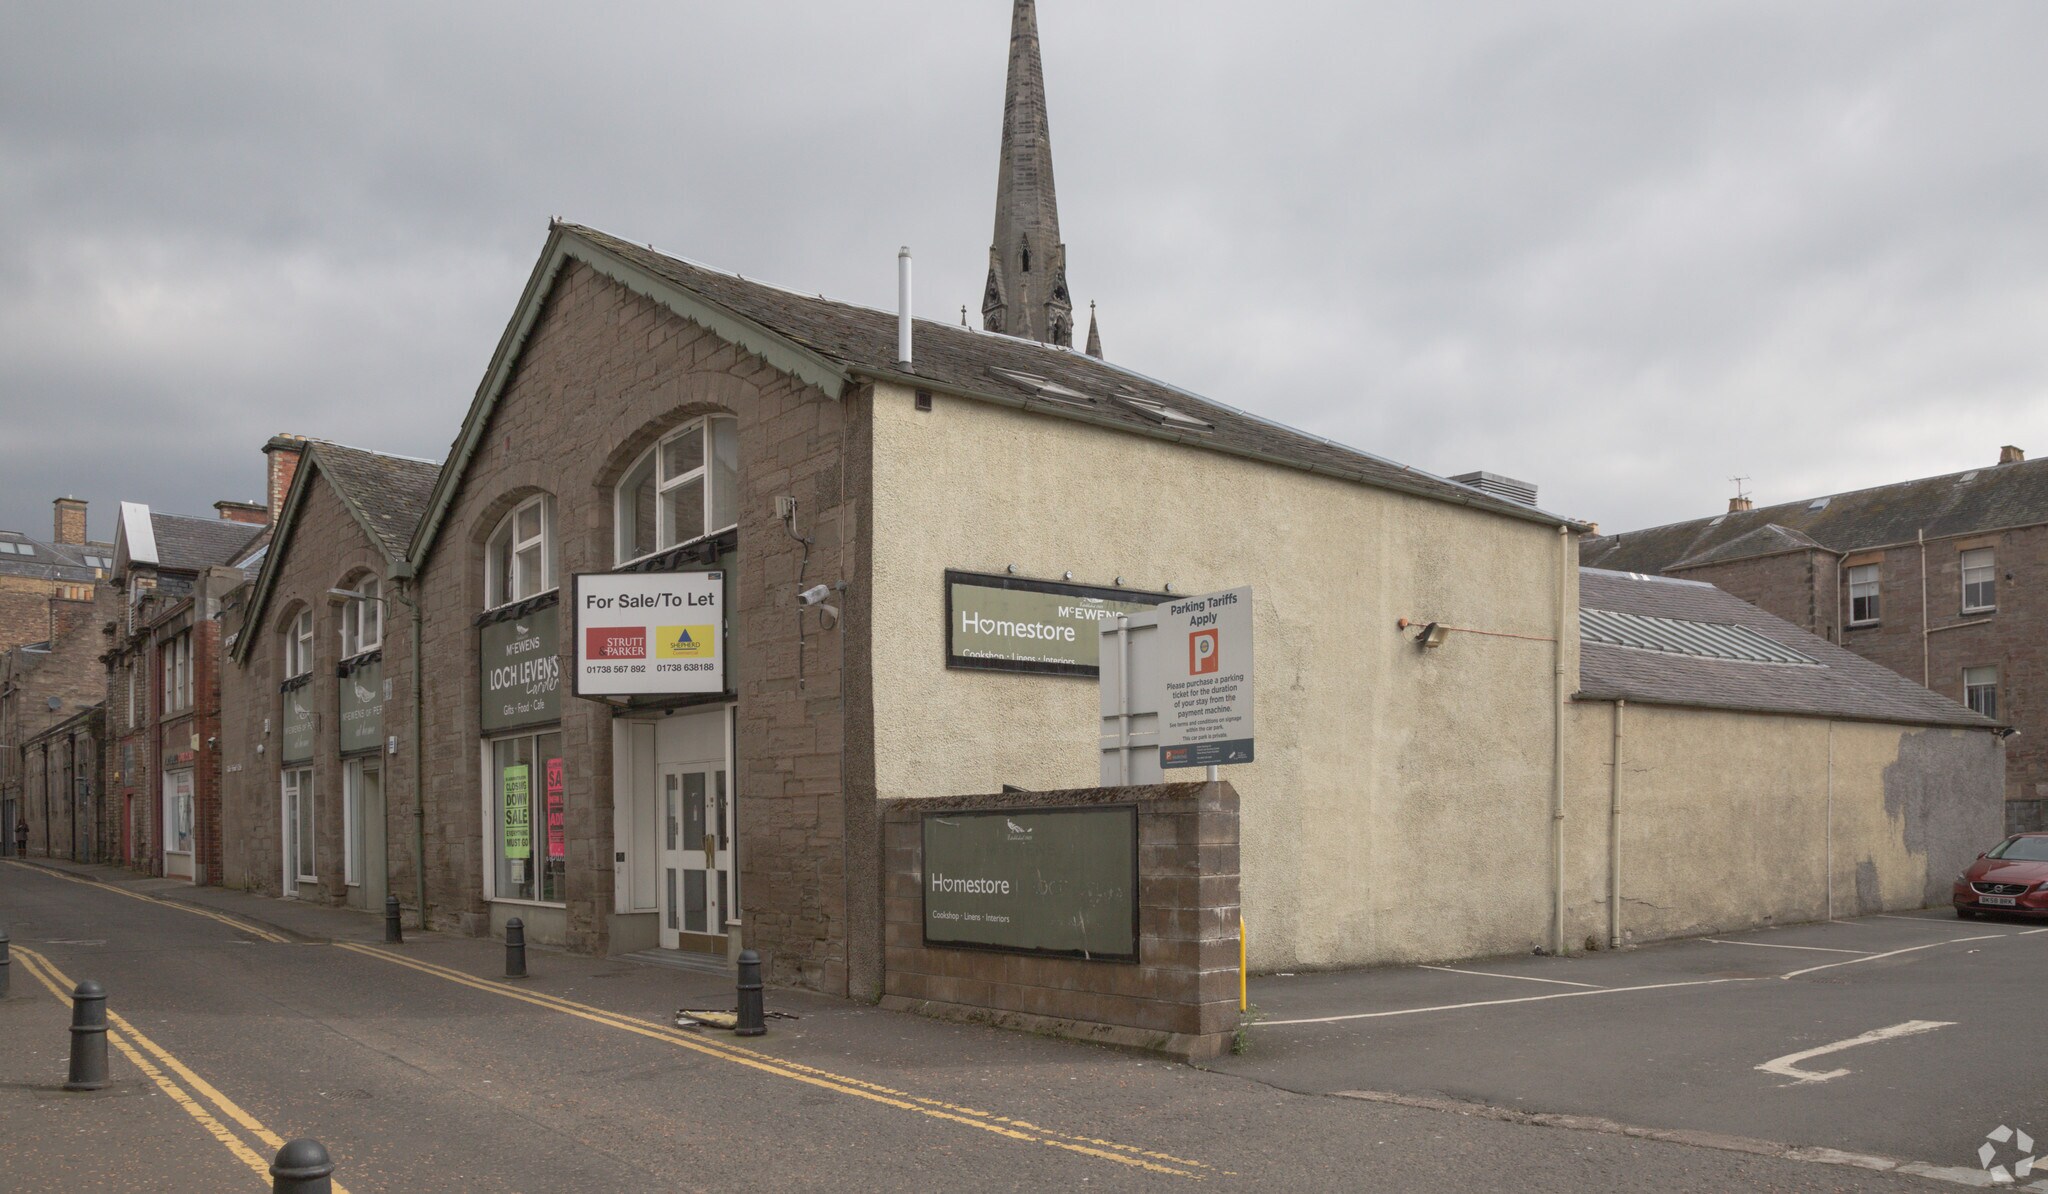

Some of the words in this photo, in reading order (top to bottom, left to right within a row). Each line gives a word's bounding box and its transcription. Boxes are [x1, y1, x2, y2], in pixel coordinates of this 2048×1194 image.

[587, 595, 613, 609] For
[619, 593, 682, 608] Sale/To
[688, 592, 714, 606] Let
[1171, 601, 1205, 615] Parking
[1207, 593, 1237, 608] Tariffs
[1190, 612, 1217, 627] Apply
[607, 637, 644, 647] STRUTT
[587, 665, 611, 674] 01738
[613, 665, 628, 674] 567
[630, 665, 646, 673] 892
[656, 664, 682, 672] 01738
[684, 663, 714, 672] 638188
[490, 664, 517, 691] LOCH
[1167, 681, 1185, 691] Please
[1186, 676, 1213, 689] purchase
[1220, 674, 1244, 684] parking
[1173, 690, 1189, 699] ticket
[1200, 687, 1210, 696] the
[1211, 684, 1237, 694] duration
[517, 702, 529, 713] Food
[1181, 700, 1195, 709] your
[1196, 698, 1208, 706] stay
[1209, 695, 1224, 704] from
[1225, 694, 1236, 702] the
[1178, 707, 1203, 718] payment
[1204, 704, 1232, 715] machine.
[506, 781, 527, 791] CLOSING
[506, 793, 527, 806] DOWN
[506, 809, 527, 825] SALE
[507, 828, 528, 837] EVERYTHING
[507, 838, 521, 848] MUST
[522, 838, 528, 847] GO
[933, 910, 960, 922] Cookshop
[964, 912, 981, 922] Linens
[985, 913, 1010, 924] Interiors
